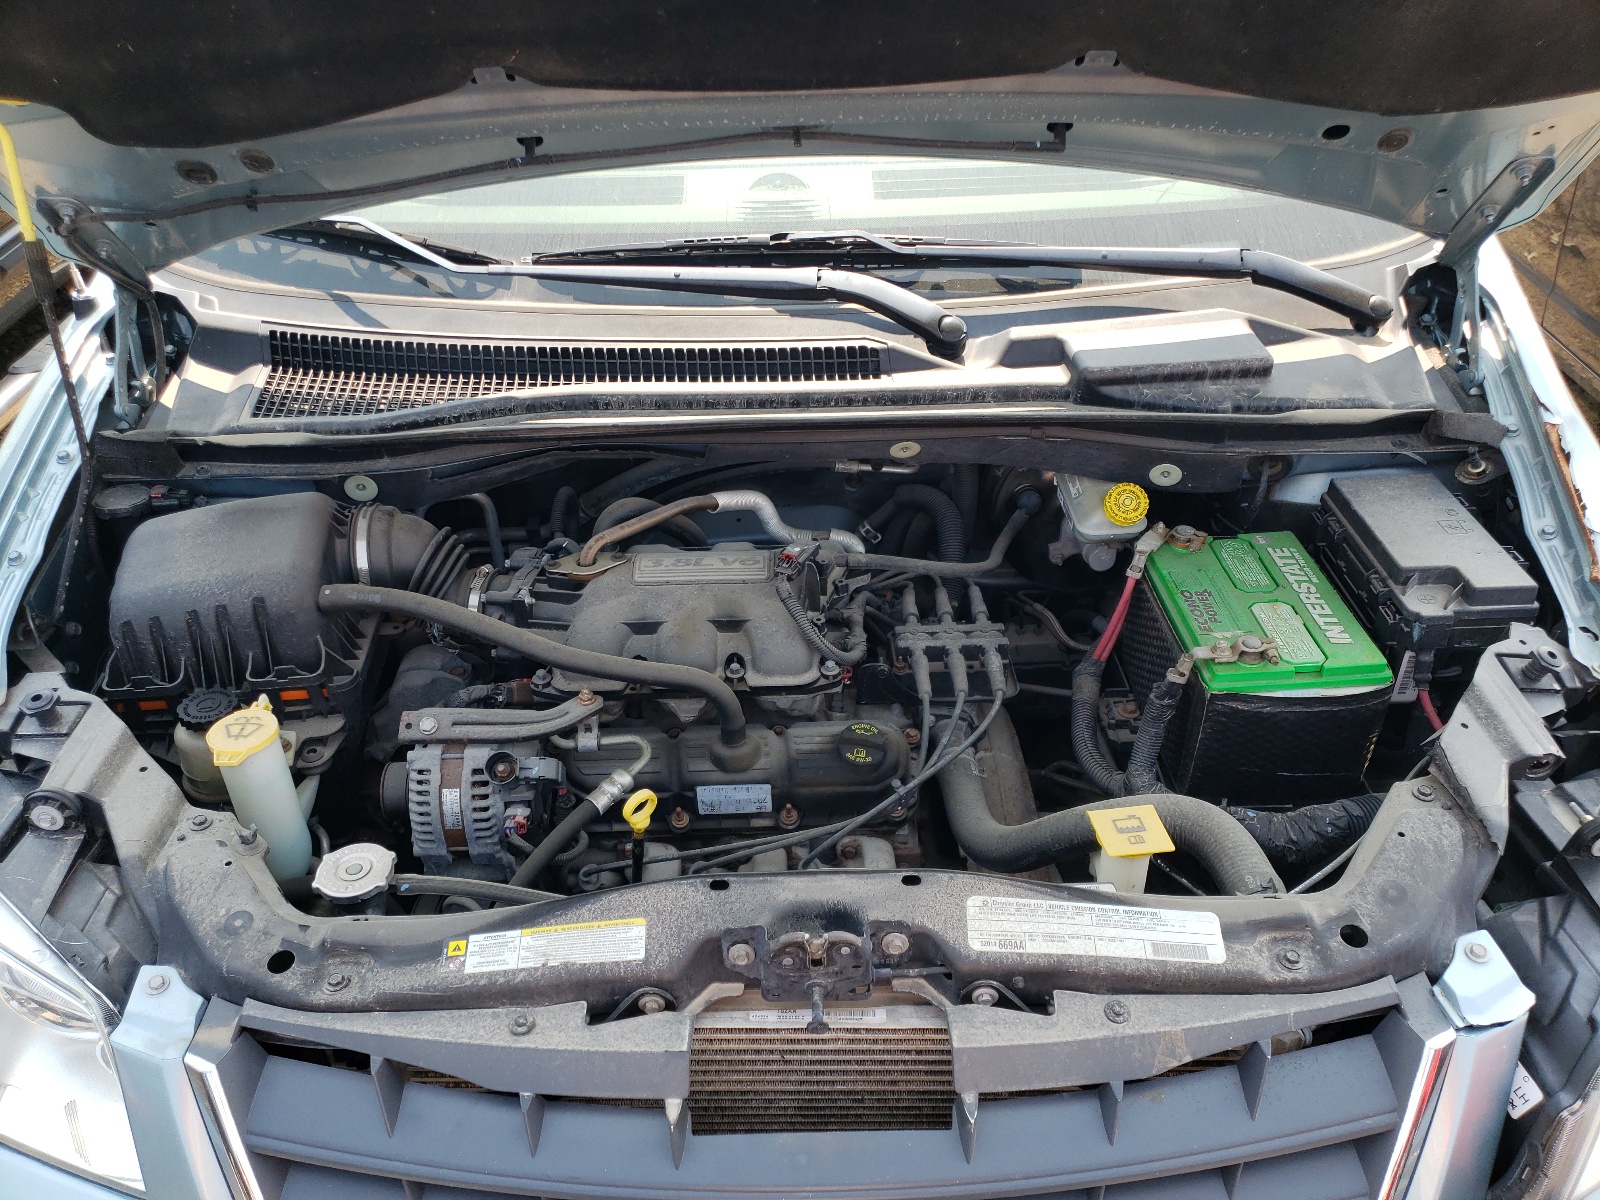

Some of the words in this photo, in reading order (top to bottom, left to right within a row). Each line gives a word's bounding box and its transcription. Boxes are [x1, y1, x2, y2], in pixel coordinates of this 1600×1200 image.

[644, 558, 713, 568] 3.8L
[717, 557, 761, 567] V6
[1266, 547, 1354, 644] INTERSTATE
[1180, 589, 1213, 633] ECONO
[1194, 588, 1222, 624] POWER
[1015, 901, 1032, 909] Group
[1047, 903, 1070, 911] VEHICLE
[1071, 905, 1097, 913] EMISSION
[1097, 907, 1122, 915] CONTROL
[1122, 909, 1159, 918] INFORMATION
[998, 940, 1025, 951] 669AA
[1513, 1086, 1530, 1105] LH
